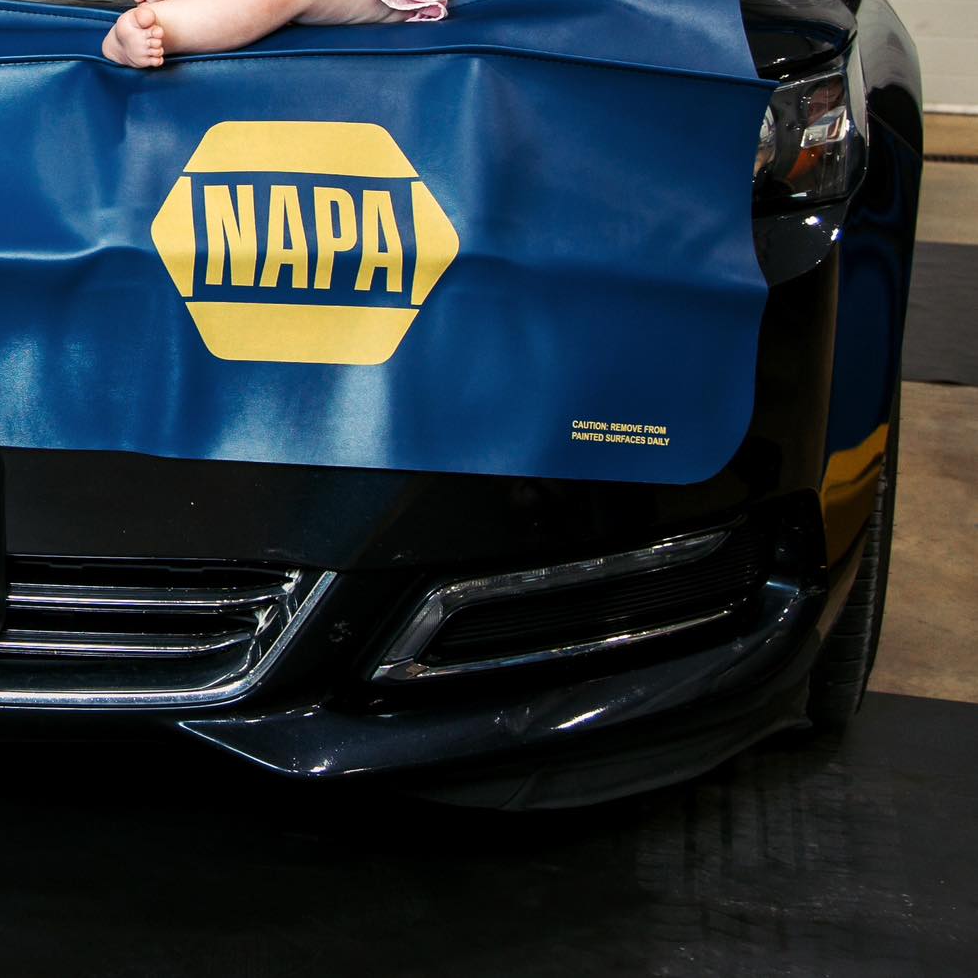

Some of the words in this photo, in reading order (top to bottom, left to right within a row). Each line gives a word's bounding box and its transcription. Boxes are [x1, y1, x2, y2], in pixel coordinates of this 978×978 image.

[203, 184, 404, 293] NAPA
[572, 420, 609, 431] CAUTION:
[610, 422, 643, 433] REMOVE
[644, 425, 667, 435] FROM
[571, 431, 604, 442] PAINTED
[605, 433, 646, 445] SURFACES
[647, 436, 670, 446] DAILY
